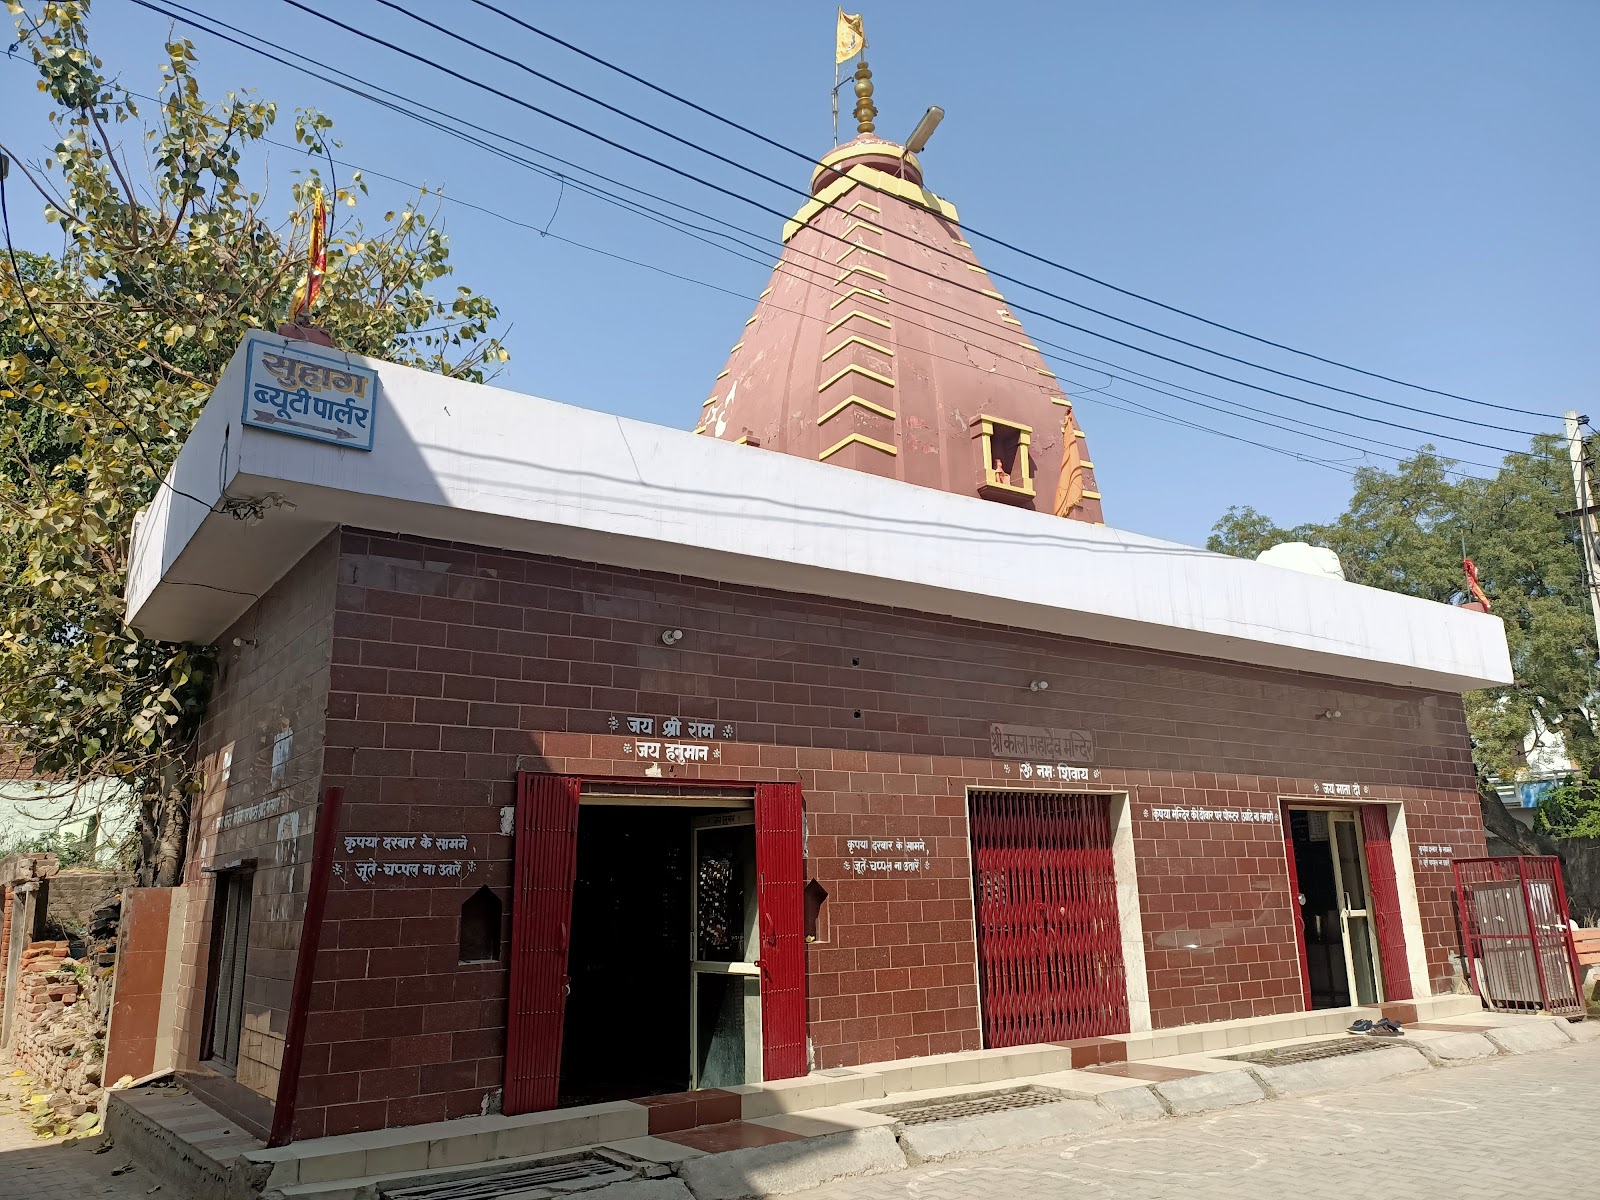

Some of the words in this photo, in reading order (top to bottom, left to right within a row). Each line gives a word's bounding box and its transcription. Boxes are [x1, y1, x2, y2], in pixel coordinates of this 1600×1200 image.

[262, 352, 369, 398] सुहाग
[254, 383, 312, 419] ब्यूटी
[313, 398, 369, 428] पार्लर
[627, 717, 654, 735] जय
[662, 716, 682, 737] श्री
[688, 722, 715, 739] राम
[990, 726, 1003, 752] श्री
[1003, 734, 1029, 755] काला
[636, 742, 661, 759] जय
[664, 743, 709, 765] हनुमान
[1057, 763, 1089, 781] शिवाय
[1322, 782, 1335, 794] जय
[1335, 783, 1351, 796] माता
[1152, 808, 1171, 821] कृपया
[344, 836, 380, 854] कृपया
[383, 836, 417, 851] दरबार
[420, 834, 433, 849] के
[847, 840, 869, 854] कृपया
[871, 840, 894, 853] दरबार
[896, 838, 904, 850] के
[423, 864, 436, 876] ना
[895, 861, 902, 871] ना
